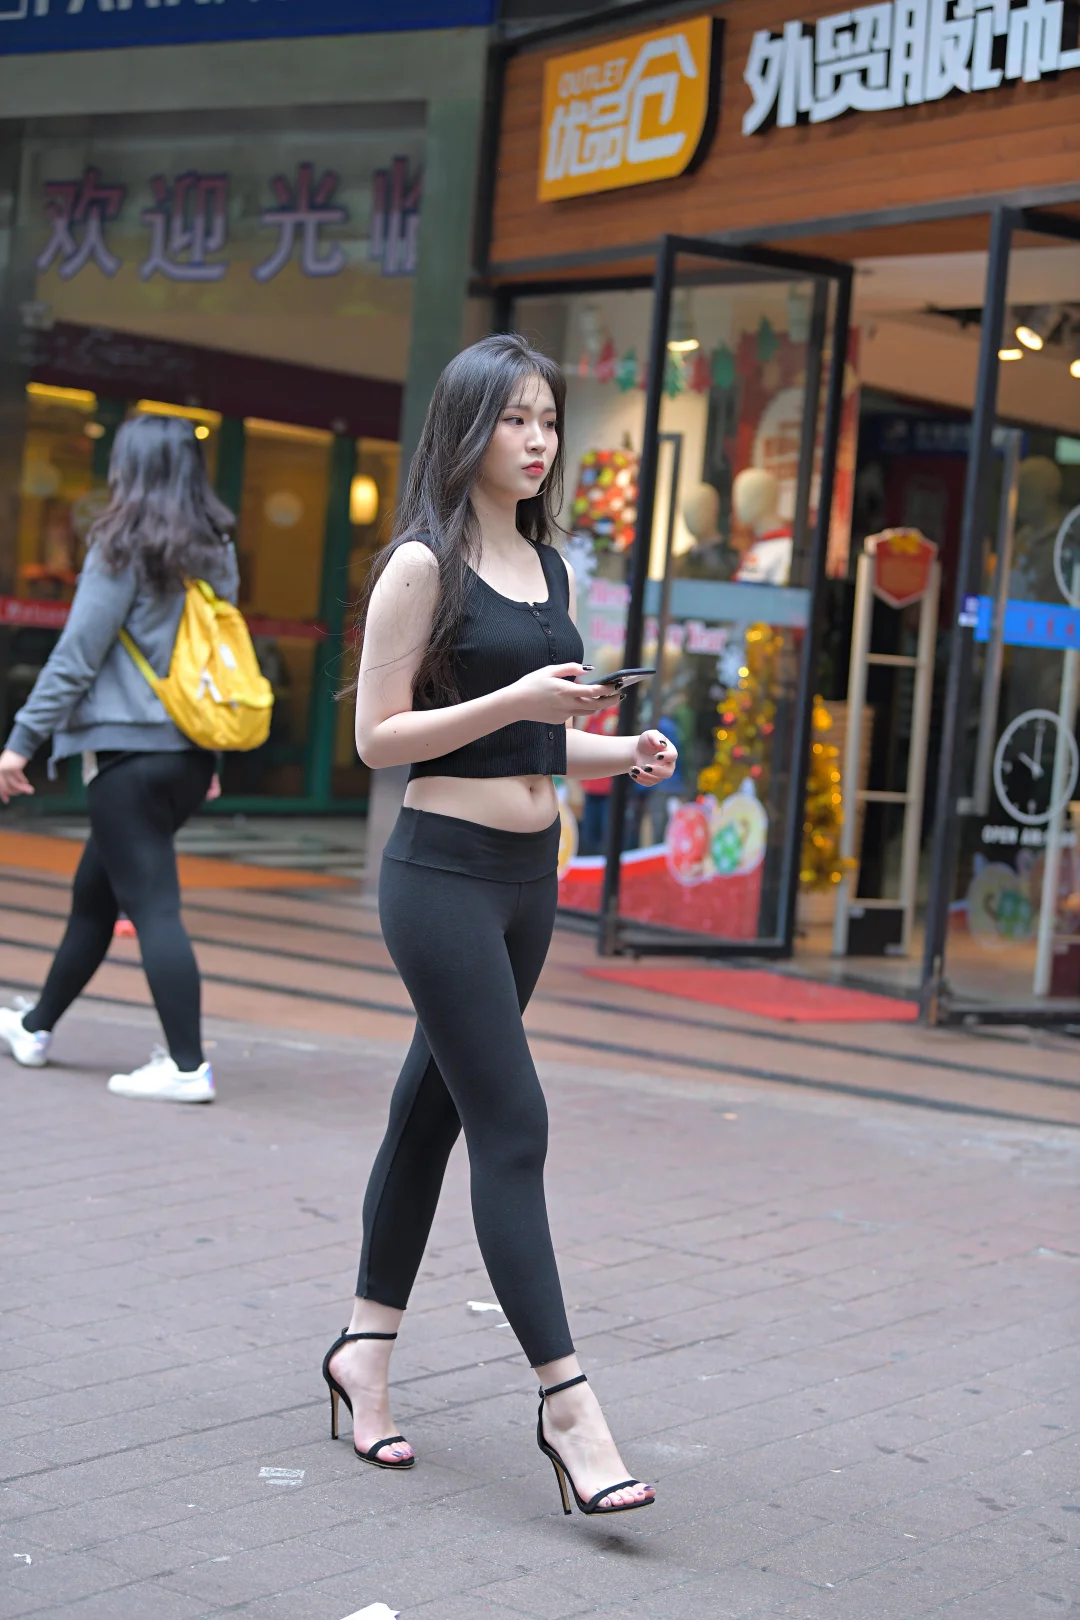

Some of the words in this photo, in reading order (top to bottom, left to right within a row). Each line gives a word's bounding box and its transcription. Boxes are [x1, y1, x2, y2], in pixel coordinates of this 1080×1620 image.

[558, 56, 628, 99] OUTLET
[742, 0, 1080, 136] 外贸服饰
